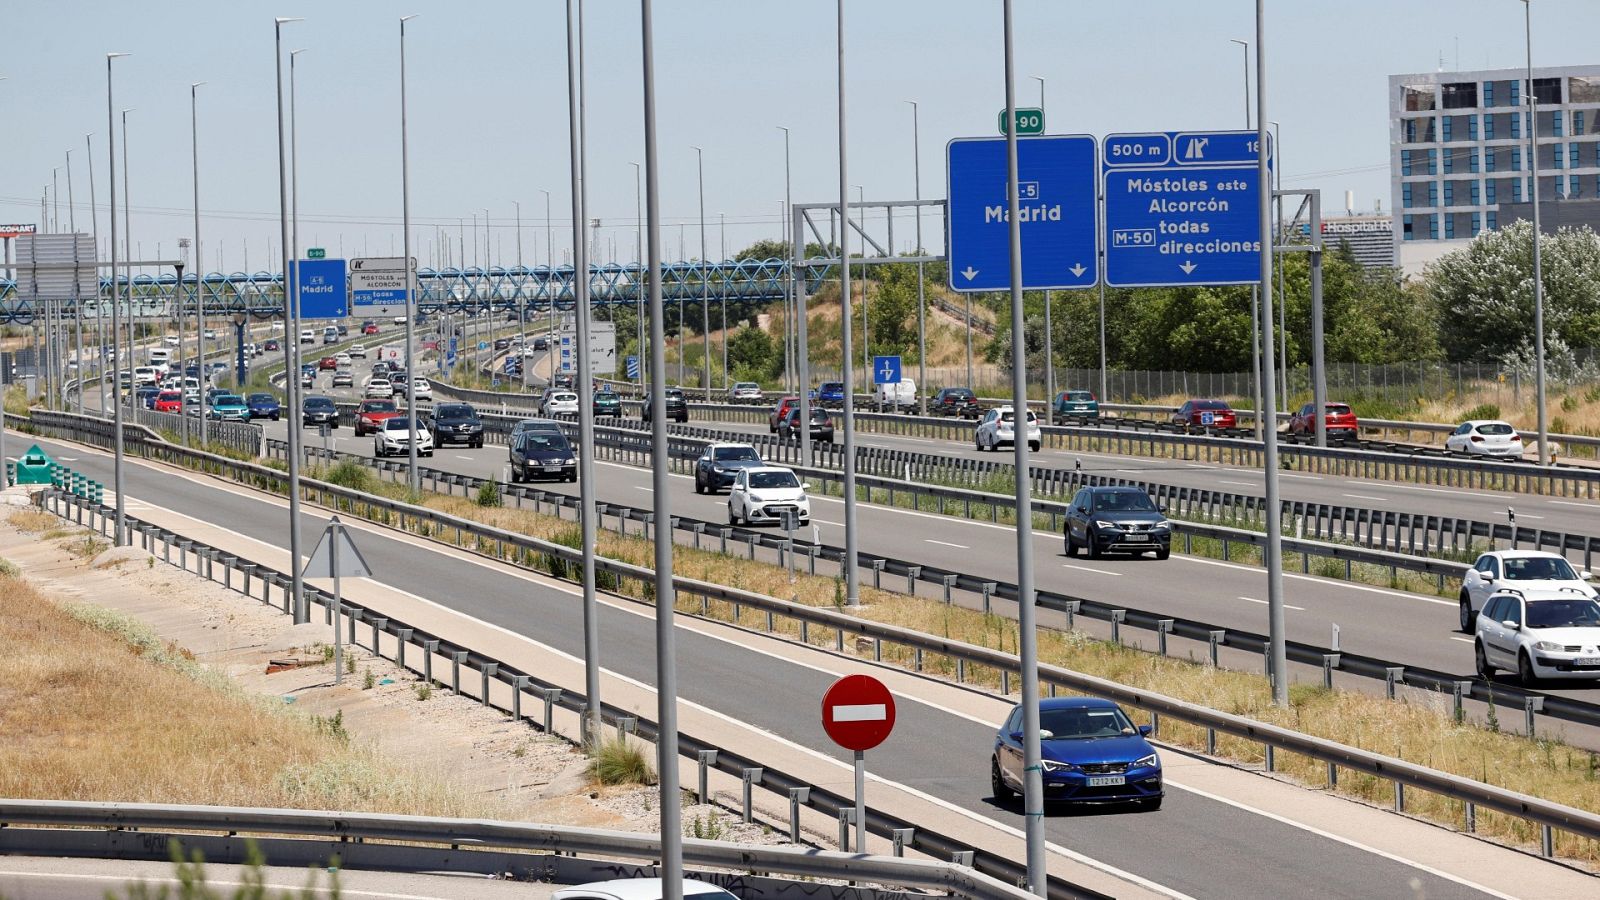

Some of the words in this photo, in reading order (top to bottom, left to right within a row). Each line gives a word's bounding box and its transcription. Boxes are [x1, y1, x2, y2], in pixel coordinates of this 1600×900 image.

[1006, 116, 1039, 128] -90
[1112, 144, 1143, 156] 500
[1148, 146, 1161, 155] m
[1128, 178, 1208, 193] Móstoles
[1217, 180, 1247, 191] este
[1149, 197, 1229, 213] Alcorcón
[1159, 220, 1210, 234] todas
[1327, 220, 1377, 235] Hospital
[1115, 232, 1152, 244] M-50
[1159, 239, 1261, 254] direcciones
[302, 285, 333, 293] Madrid
